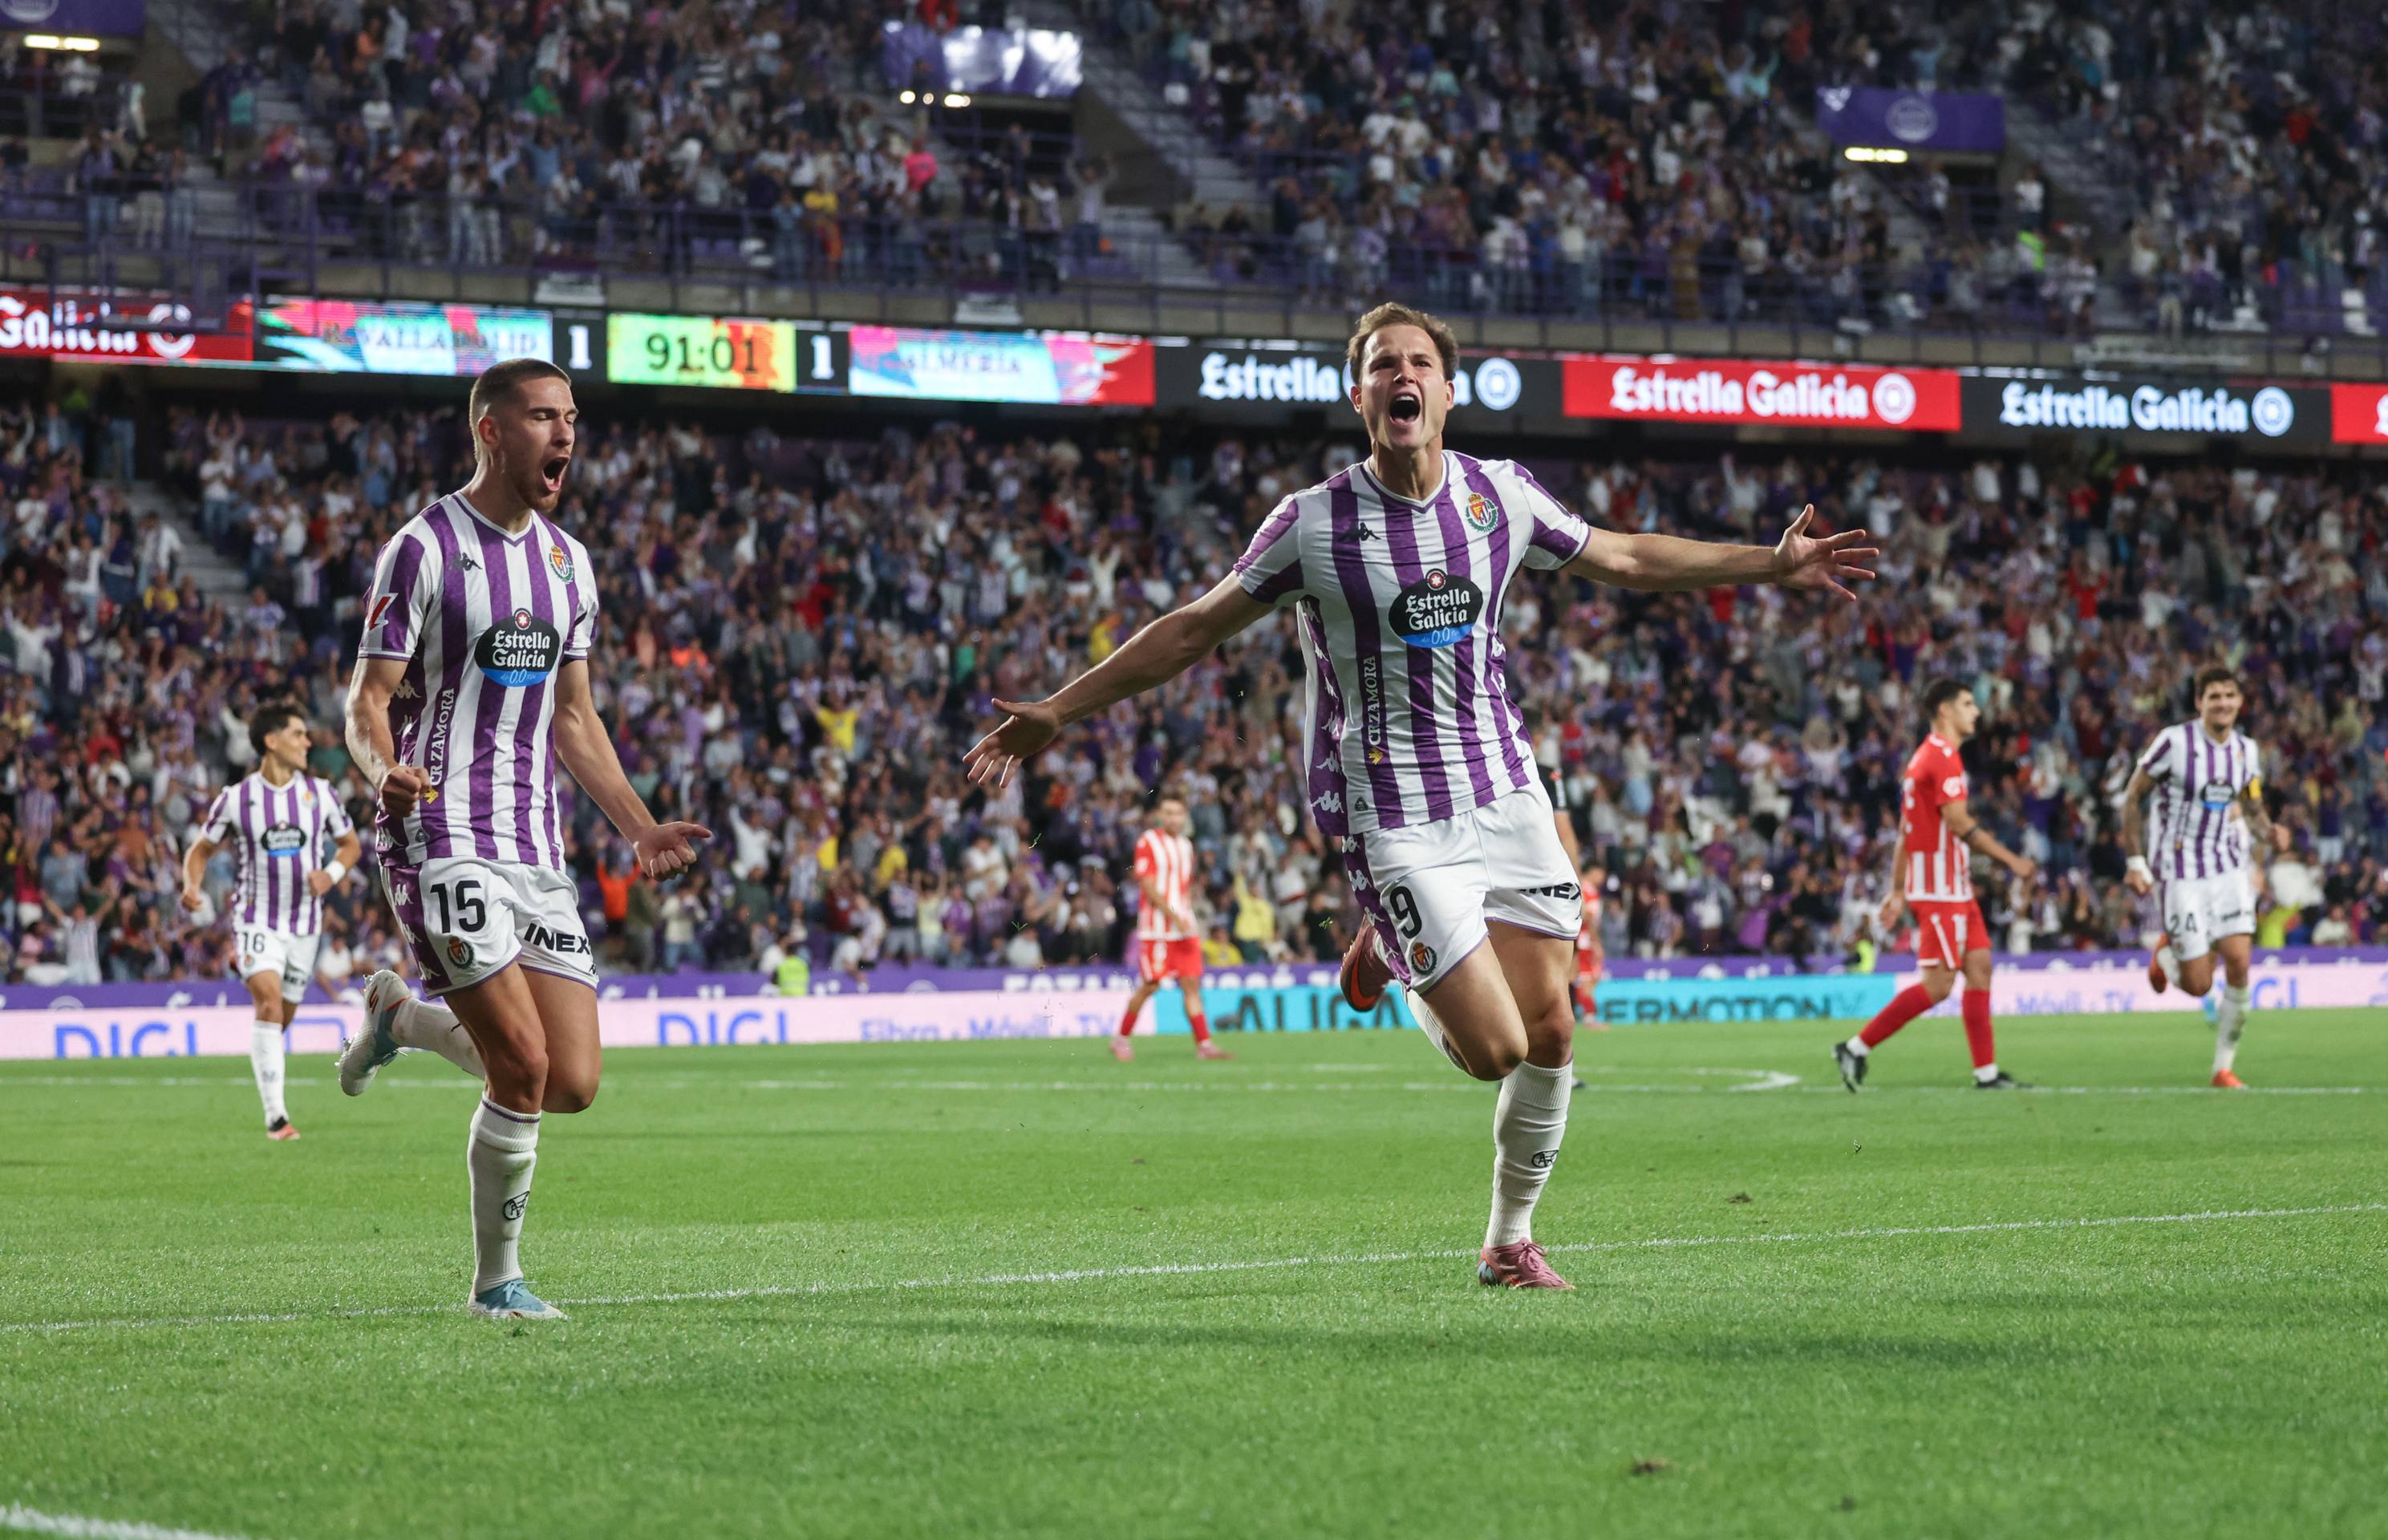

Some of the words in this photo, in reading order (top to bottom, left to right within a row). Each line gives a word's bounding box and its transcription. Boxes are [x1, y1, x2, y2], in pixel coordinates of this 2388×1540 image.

[568, 325, 592, 370] 1
[647, 333, 756, 374] 91:01
[810, 335, 834, 379] 1
[1198, 351, 1341, 402] Estrella
[1609, 366, 1745, 415] Estrella
[1746, 370, 1869, 419] Galicia
[2000, 381, 2131, 429] Estrella
[2131, 384, 2249, 433] Galicia
[1405, 587, 1471, 613] Estrella
[1409, 606, 1468, 631] Galicia
[1431, 627, 1451, 645] 0,0
[492, 630, 550, 650] Estrella
[493, 648, 546, 668] Galicia
[509, 668, 528, 684] 0,0
[430, 880, 486, 934] 15
[1389, 886, 1422, 938] 9
[242, 931, 266, 954] 16
[1605, 993, 1832, 1022] ERMOTION
